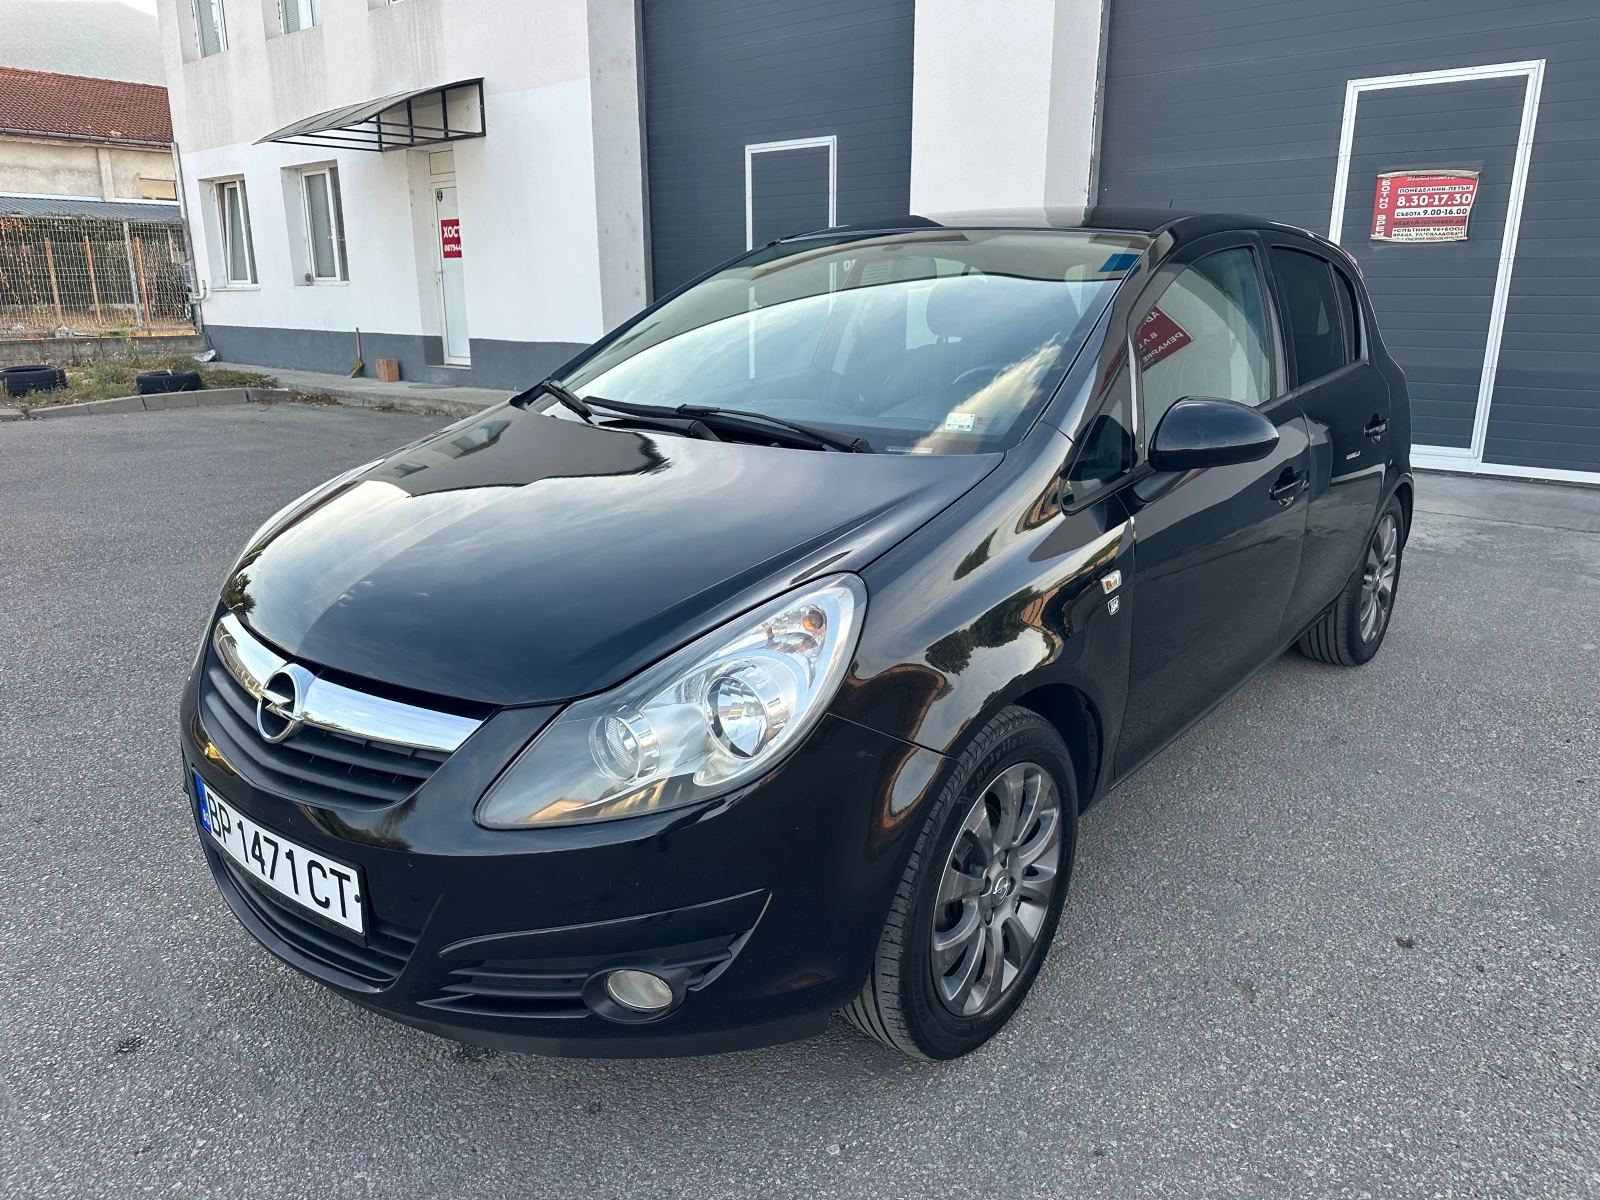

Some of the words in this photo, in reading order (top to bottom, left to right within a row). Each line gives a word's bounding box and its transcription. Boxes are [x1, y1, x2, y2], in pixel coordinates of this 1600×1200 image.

[1399, 185, 1471, 194] ПОНЕДЕЛНИК-ПЕТЪК
[1397, 193, 1472, 207] 8.30-17.30
[1422, 208, 1468, 216] 9.00-16.00
[206, 791, 232, 844] BP
[237, 820, 300, 896] 1471
[306, 859, 352, 919] CT
